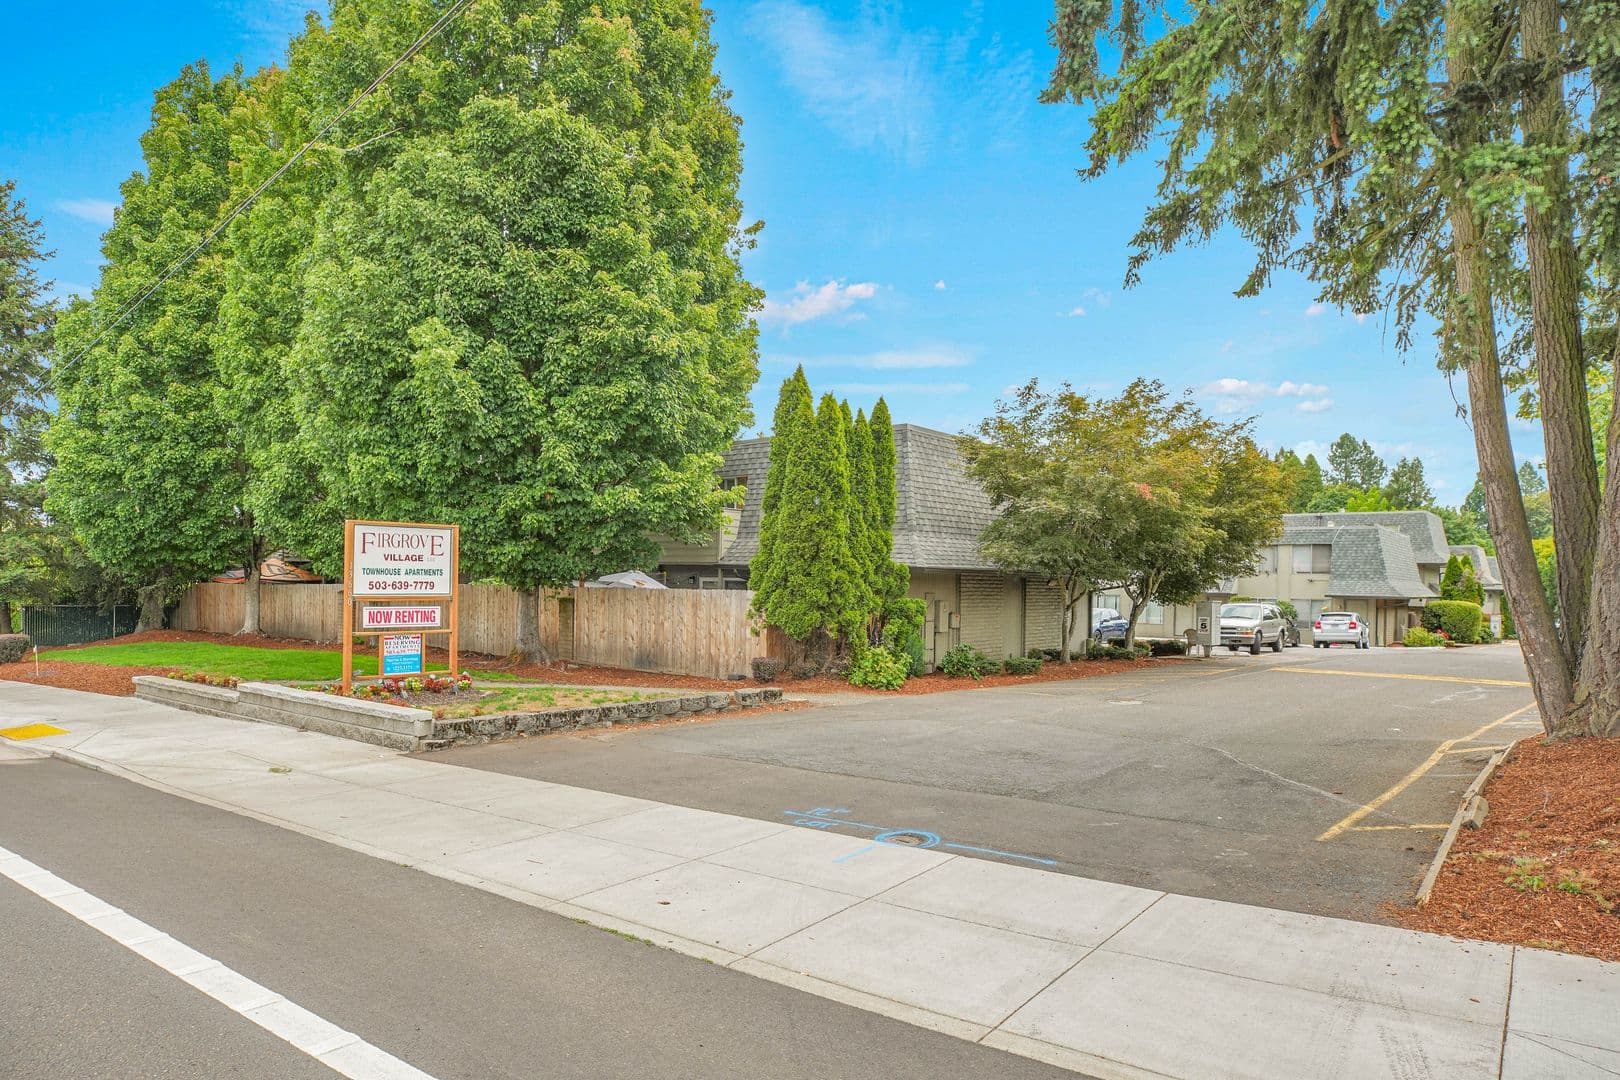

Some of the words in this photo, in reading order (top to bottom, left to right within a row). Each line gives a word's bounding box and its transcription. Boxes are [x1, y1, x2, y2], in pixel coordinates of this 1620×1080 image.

[361, 532, 444, 556] FIRGROVE
[384, 553, 424, 562] VILLAGE
[362, 568, 401, 576] TOWNHOUSE
[368, 580, 435, 590] 503-639-7779
[368, 610, 393, 624] NOW
[395, 610, 436, 623] RENTING
